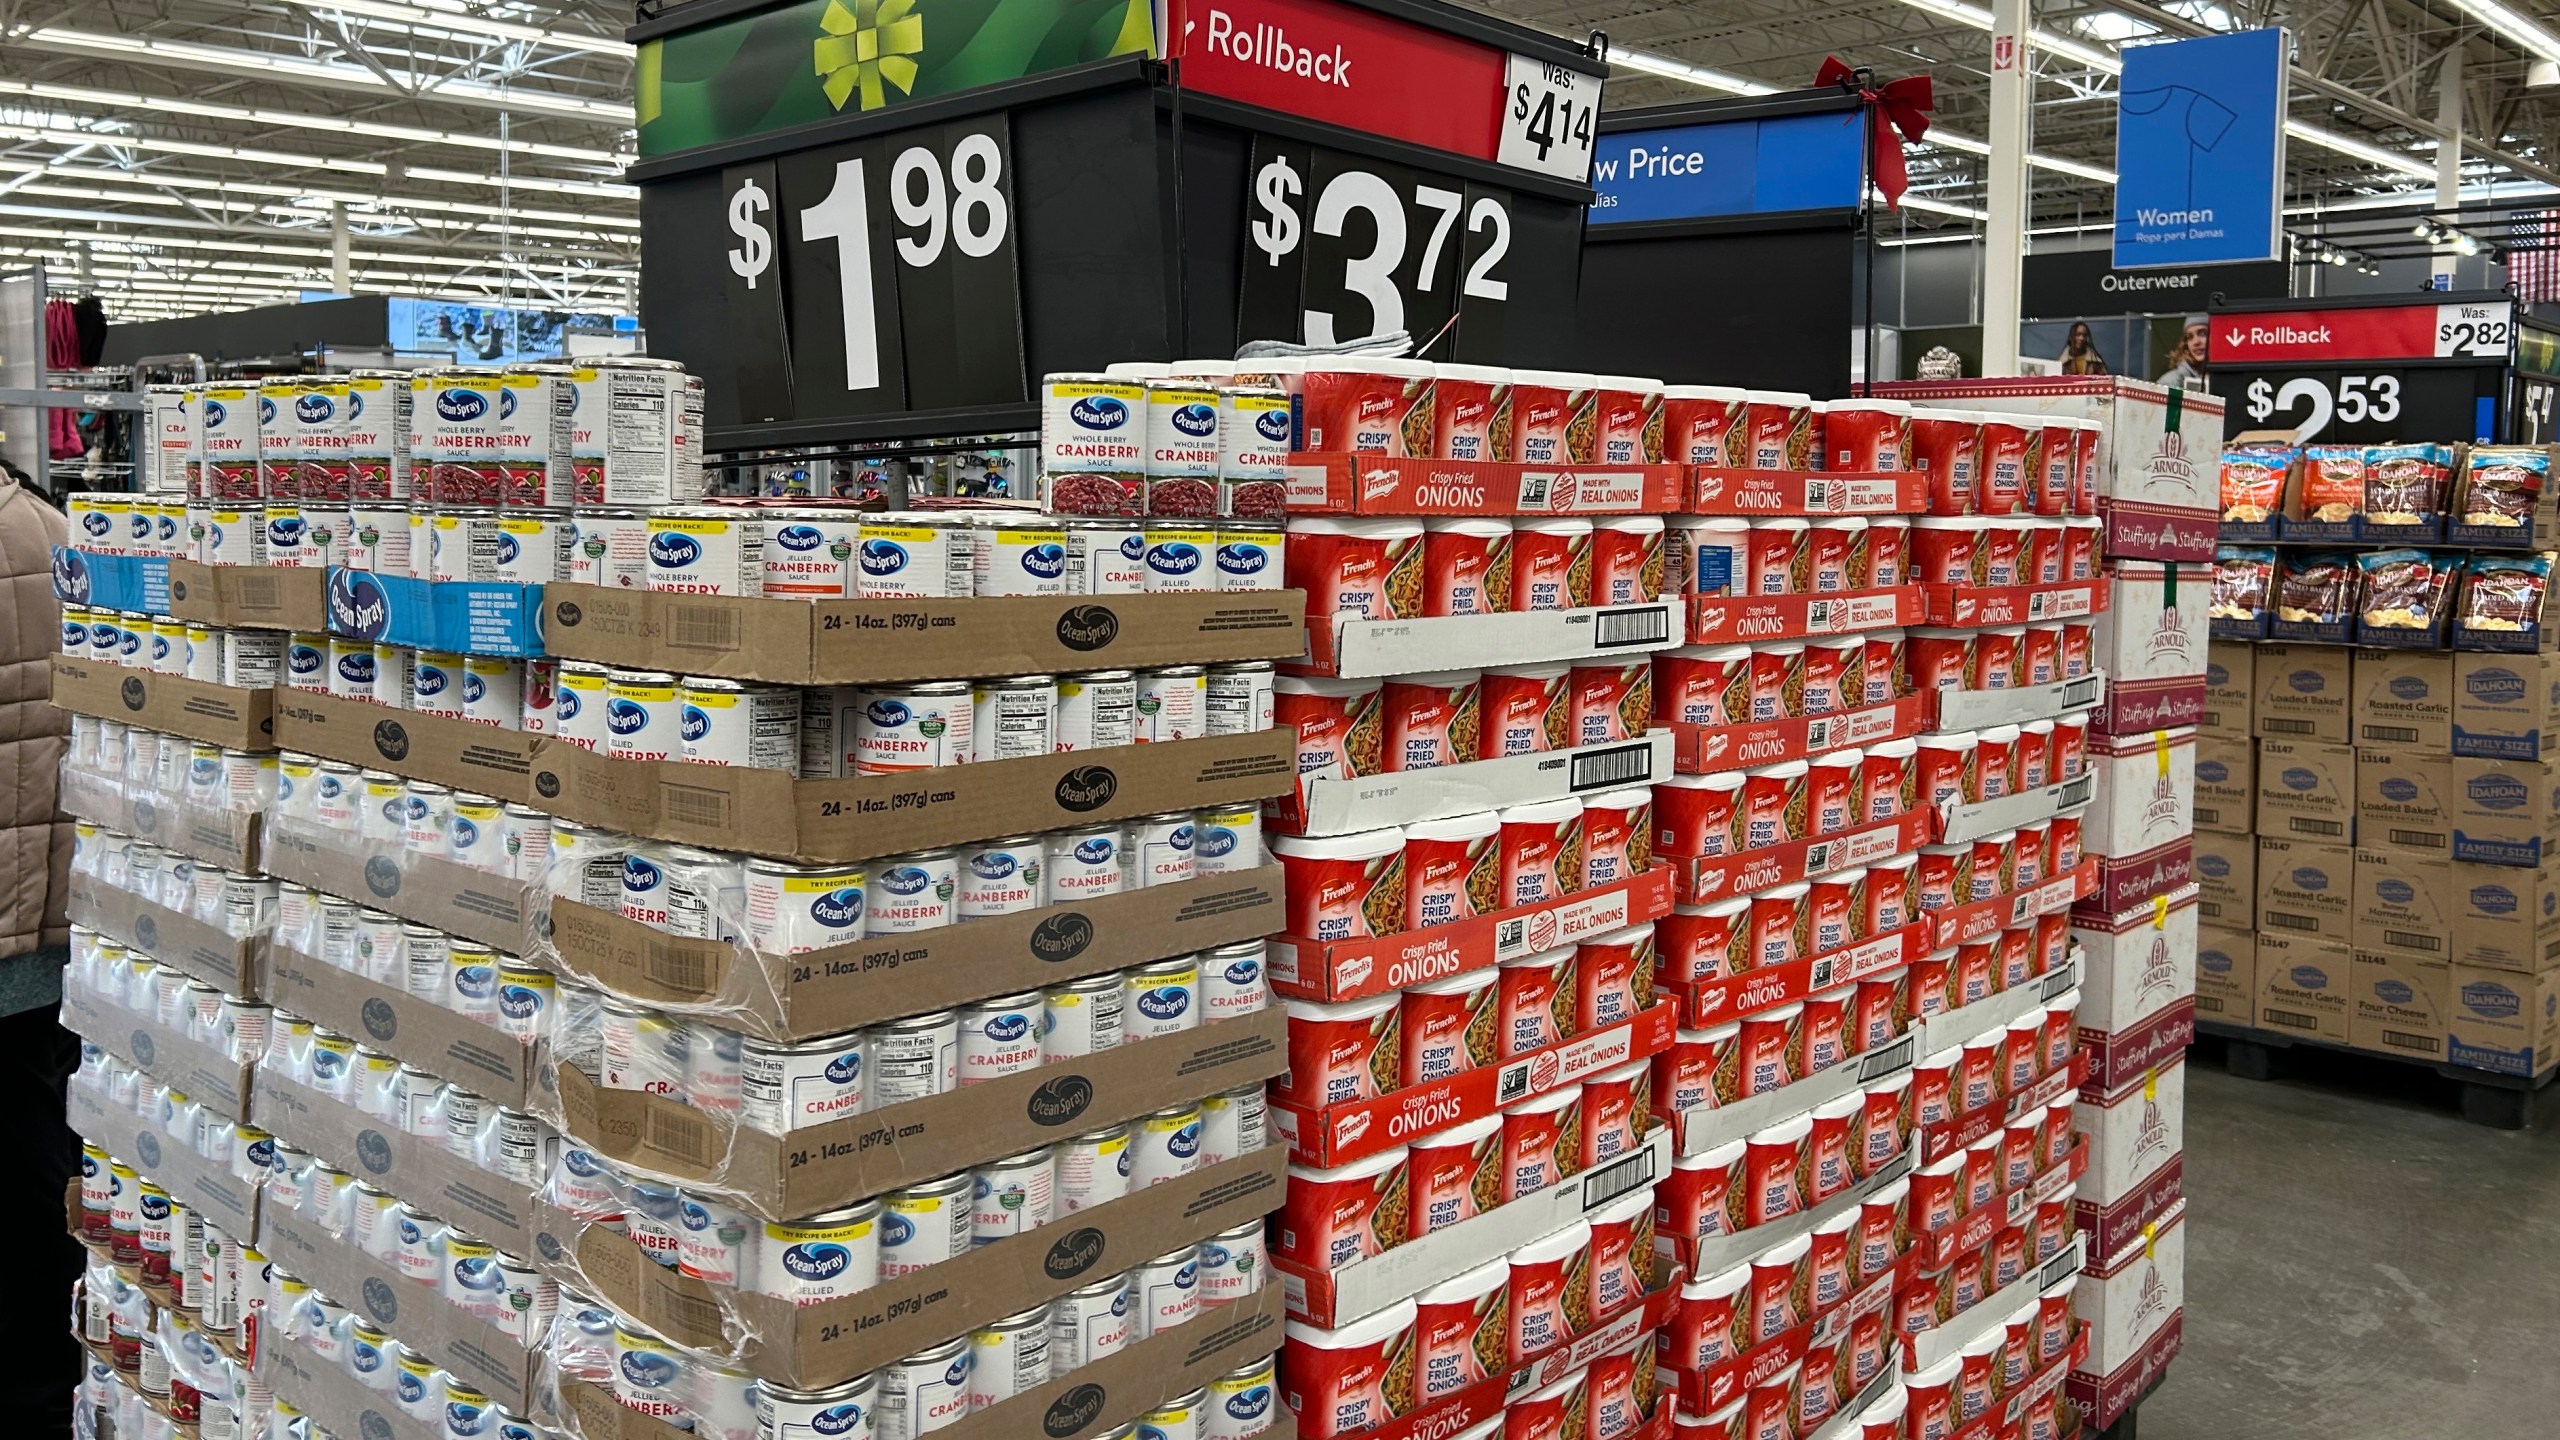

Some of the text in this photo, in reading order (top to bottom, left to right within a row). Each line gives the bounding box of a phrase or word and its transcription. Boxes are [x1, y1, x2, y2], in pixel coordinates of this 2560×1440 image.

[1208, 11, 1352, 88] Rollback
[1542, 61, 1575, 90] Was:
[1629, 146, 1704, 179] Price
[2137, 208, 2213, 227] Women
[2136, 229, 2224, 243] Ropa para Damas
[2101, 274, 2198, 292] Outerwear
[2461, 308, 2490, 318] Was:
[2251, 326, 2331, 345] Rollback
[653, 401, 664, 409] 110
[1360, 396, 1395, 414] French's
[1073, 406, 1123, 427] Ocean Spray
[1072, 435, 1102, 443] WHOLE
[1357, 432, 1392, 446] CRISPY
[1452, 435, 1481, 448] CRISPY
[1056, 445, 1139, 458] CRANBERRY
[1452, 448, 1478, 459] FRIED
[1087, 459, 1113, 467] SAUCE
[1996, 463, 2019, 473] CRISPY
[2152, 460, 2190, 477] ARNOLD
[1429, 472, 1473, 484] Crispy Fried
[1995, 471, 2015, 480] FRIED
[2378, 467, 2420, 481] IDAHOAN
[1366, 472, 1398, 493] French's
[1744, 479, 1774, 490] Crispy Fried
[1995, 479, 2020, 488] ONIONS
[1416, 485, 1484, 507] ONIONS
[1581, 489, 1638, 502] REAL ONIONS
[1734, 491, 1782, 508] ONIONS
[1850, 494, 1894, 505] REAL ONIONS
[2284, 523, 2353, 535] FAMILY SIZE
[2453, 527, 2529, 538] FAMILY SIZE
[780, 533, 818, 548] Ocean Spray
[2117, 525, 2216, 551] Stuffing Stuffing
[765, 562, 838, 573] CRANBERRY
[1150, 552, 1196, 569] Ocean Spray
[1160, 579, 1190, 587] JELLIED
[331, 585, 355, 627] Ocean
[823, 612, 956, 631] 24 14oz. (397g) cans
[1060, 619, 1111, 643] Ocean Spray
[2361, 628, 2434, 643] FAMILY SIZE
[2458, 631, 2532, 643] FAMILY SIZE
[2154, 634, 2184, 648] ARNOLD
[2357, 652, 2388, 661] 13147
[2469, 681, 2522, 692] IDAHOAN
[2218, 689, 2247, 700] Garlic
[1507, 696, 1538, 715] French's
[2369, 700, 2449, 715] Roasted Garlic
[2121, 704, 2155, 724] Stuffing
[1506, 728, 1535, 741] CRISPY
[1506, 738, 1531, 751] FRIED
[2265, 742, 2294, 754] 13147
[2457, 738, 2533, 751] FAMILY SIZE
[2361, 754, 2391, 764] 13148
[2469, 784, 2526, 799] IDAHOAN
[821, 789, 955, 817] 24 14oz. (397g) cans
[2150, 801, 2175, 818] ARNOLD
[2361, 801, 2438, 816] Loaded Baked
[2459, 842, 2536, 858] FAMILY SIZE
[2118, 876, 2150, 899] Stuffing
[815, 897, 863, 924] Ocean Spray
[1563, 906, 1592, 919] MADE WITH
[2369, 907, 2423, 922] Homestyle
[1563, 907, 1624, 935] REAL ONIONS
[827, 931, 856, 943] JELLIED
[1401, 937, 1448, 959] Crispy Fried
[1336, 955, 1374, 993] French's
[1387, 948, 1460, 987] ONIONS
[2143, 966, 2171, 988] ARNOLD
[2270, 984, 2347, 1006] Roasted Garlic
[2463, 992, 2520, 1008] IDAHOAN
[2358, 1001, 2428, 1021] Four Cheese
[1515, 1016, 1544, 1031] CRISPY
[1514, 1027, 1539, 1041] FRIED
[1513, 1035, 1547, 1051] ONIONS
[2453, 1047, 2527, 1069] FAMILY SIZE
[1388, 1096, 1461, 1138] ONIONS
[782, 1229, 795, 1238] TRY
[795, 1231, 816, 1239] RECIPE
[832, 1229, 855, 1238] BACK!
[786, 1253, 844, 1276] Ocean Spray
[1433, 1320, 1466, 1342] French's
[1427, 1353, 1462, 1372] CRISPY
[1427, 1366, 1459, 1382] FRIED
[1427, 1374, 1468, 1393] ONIONS
